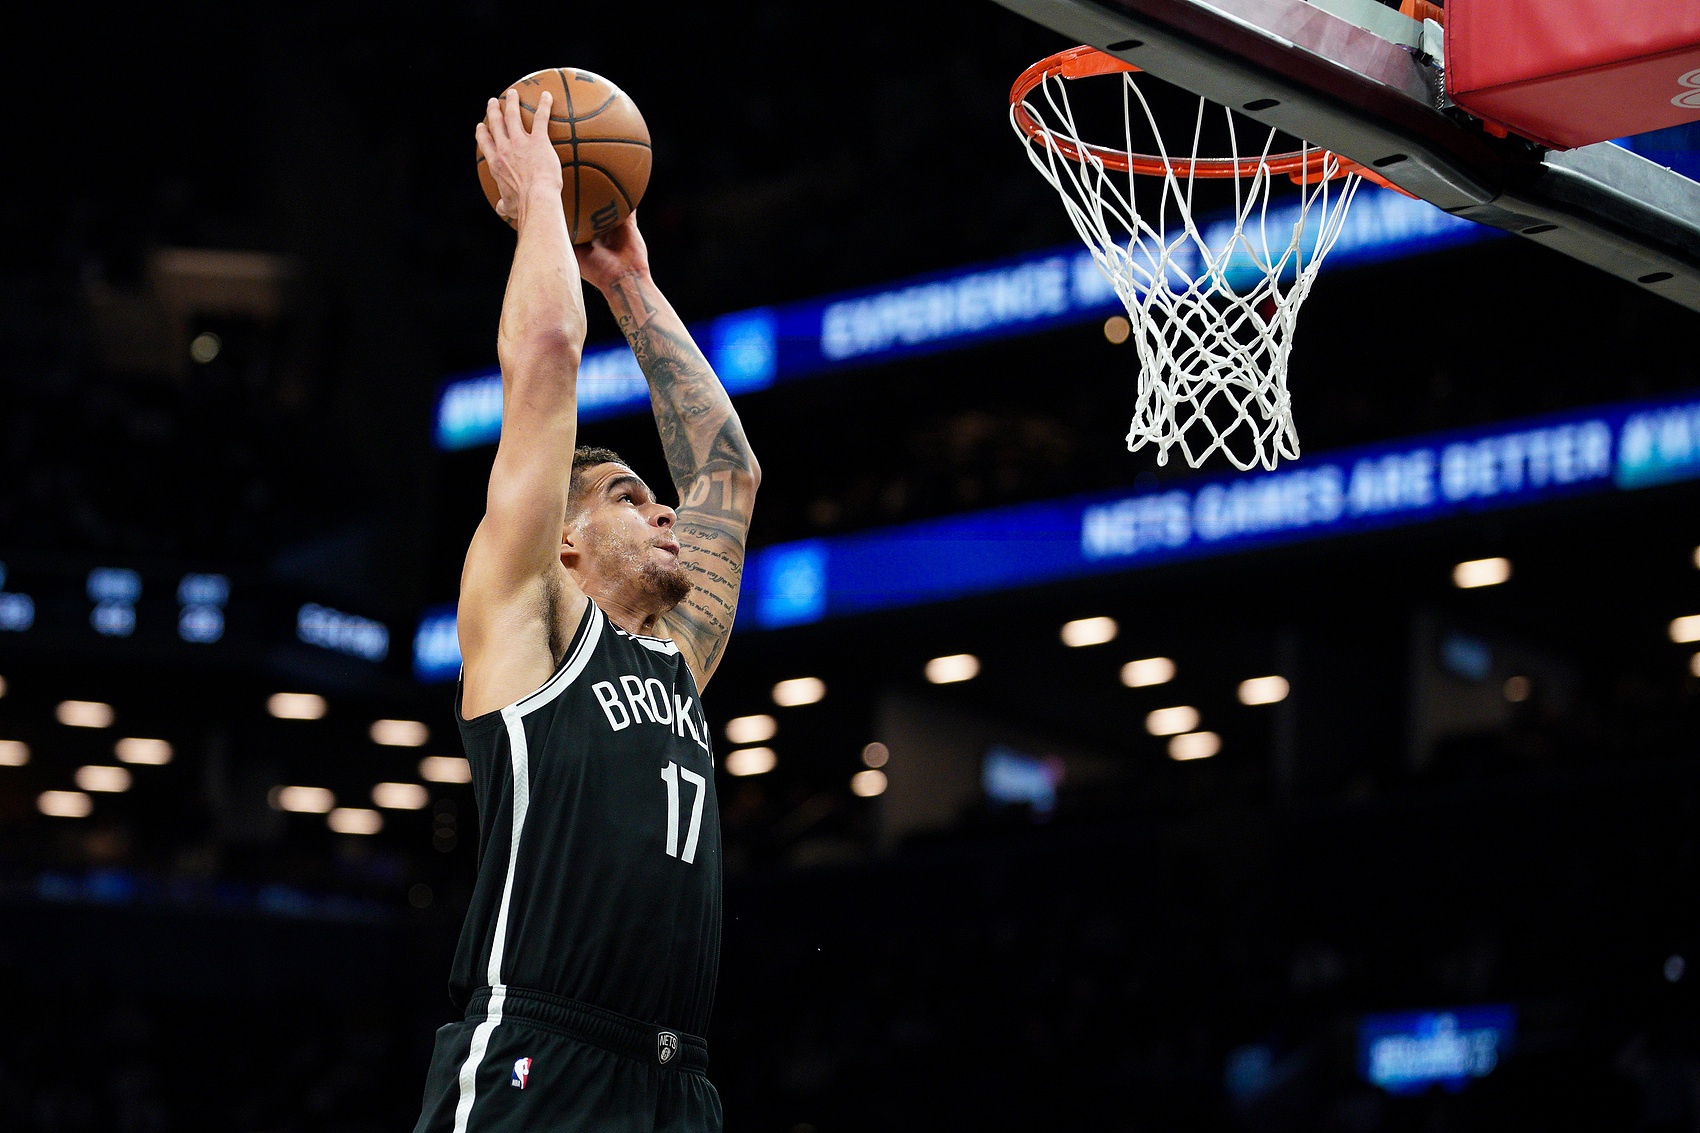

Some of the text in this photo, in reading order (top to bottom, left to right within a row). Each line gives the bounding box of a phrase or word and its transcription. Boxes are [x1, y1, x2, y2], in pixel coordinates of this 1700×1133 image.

[1082, 490, 1191, 560] NETS
[1196, 465, 1342, 539] GAMES
[1351, 449, 1433, 516] ARE
[1441, 421, 1611, 500] BETTER
[661, 760, 706, 864] 17
[660, 1035, 676, 1050] NETS
